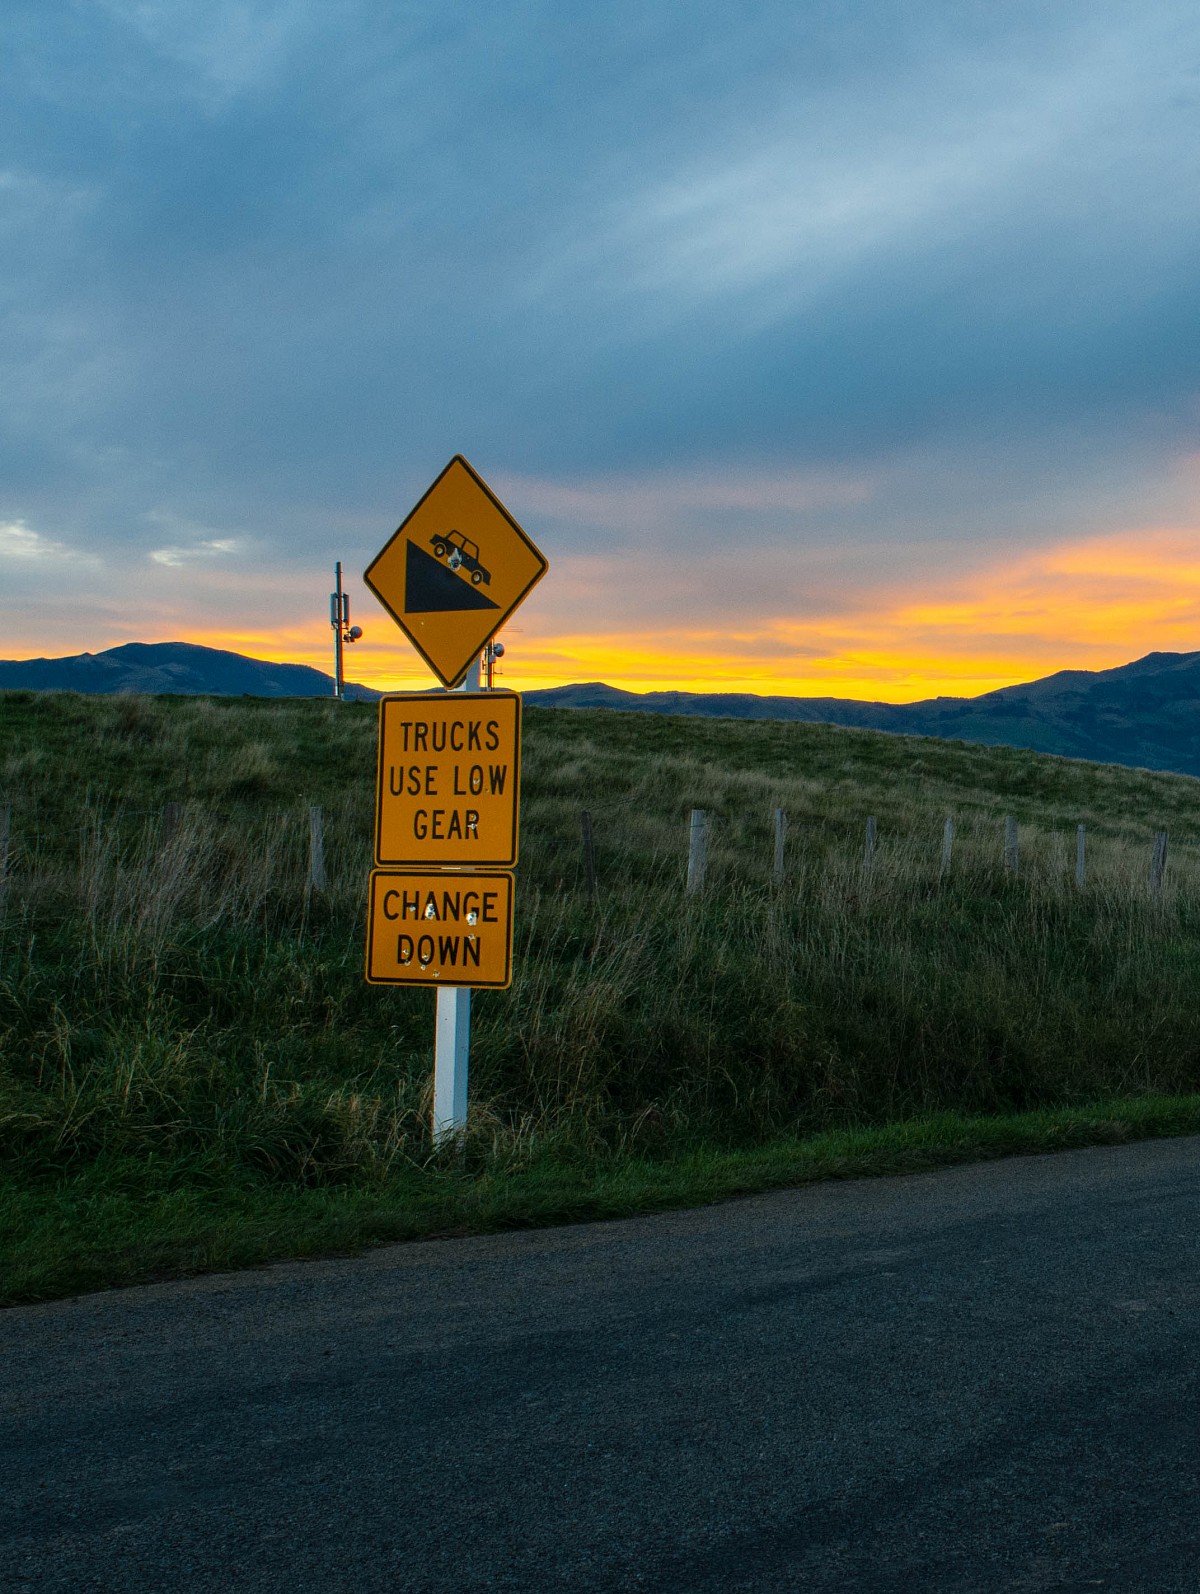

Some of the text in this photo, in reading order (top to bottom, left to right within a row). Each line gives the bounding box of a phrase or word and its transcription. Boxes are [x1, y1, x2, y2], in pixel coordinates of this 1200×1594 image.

[401, 720, 499, 752] TRUCKS
[390, 764, 507, 796] USE LOW
[414, 809, 479, 840] GEAR
[383, 889, 498, 923] CHANGE
[397, 934, 481, 967] DOWN
